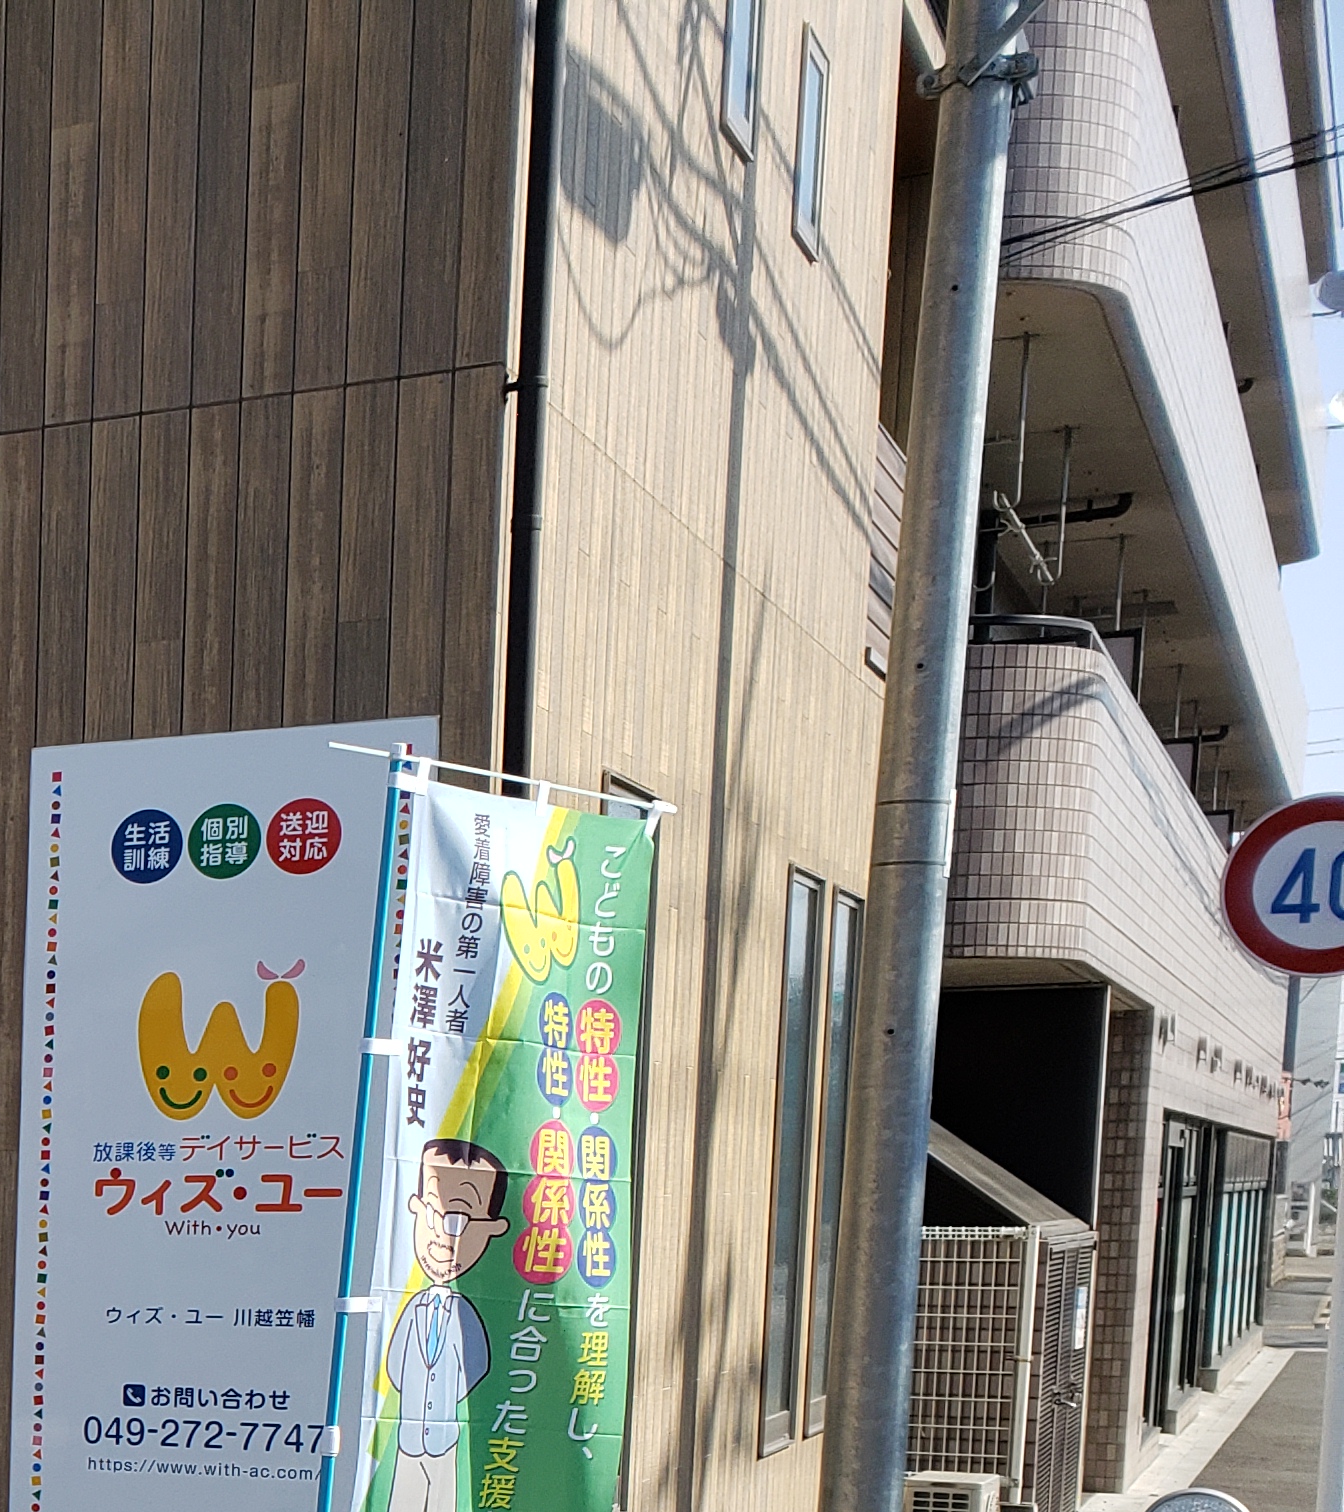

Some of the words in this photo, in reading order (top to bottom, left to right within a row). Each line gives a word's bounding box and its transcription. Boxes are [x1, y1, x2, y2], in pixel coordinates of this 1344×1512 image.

[123, 821, 171, 846] 生活
[200, 815, 249, 841] 個別
[278, 811, 329, 836] 送迎
[123, 846, 171, 871] 訓練
[200, 839, 249, 866] 指導
[278, 836, 329, 861] 対応
[445, 813, 492, 1034] 愛着障害の第一人者
[92, 1133, 345, 1163] 放課後等デイサービス
[94, 1167, 343, 1216] ウィズ・ユー
[105, 1306, 224, 1326] ウィズ・ユー
[233, 1308, 316, 1329] 川越笠幡
[150, 1386, 291, 1411] お問い合わせ
[83, 1415, 324, 1454] 049-272-7747
